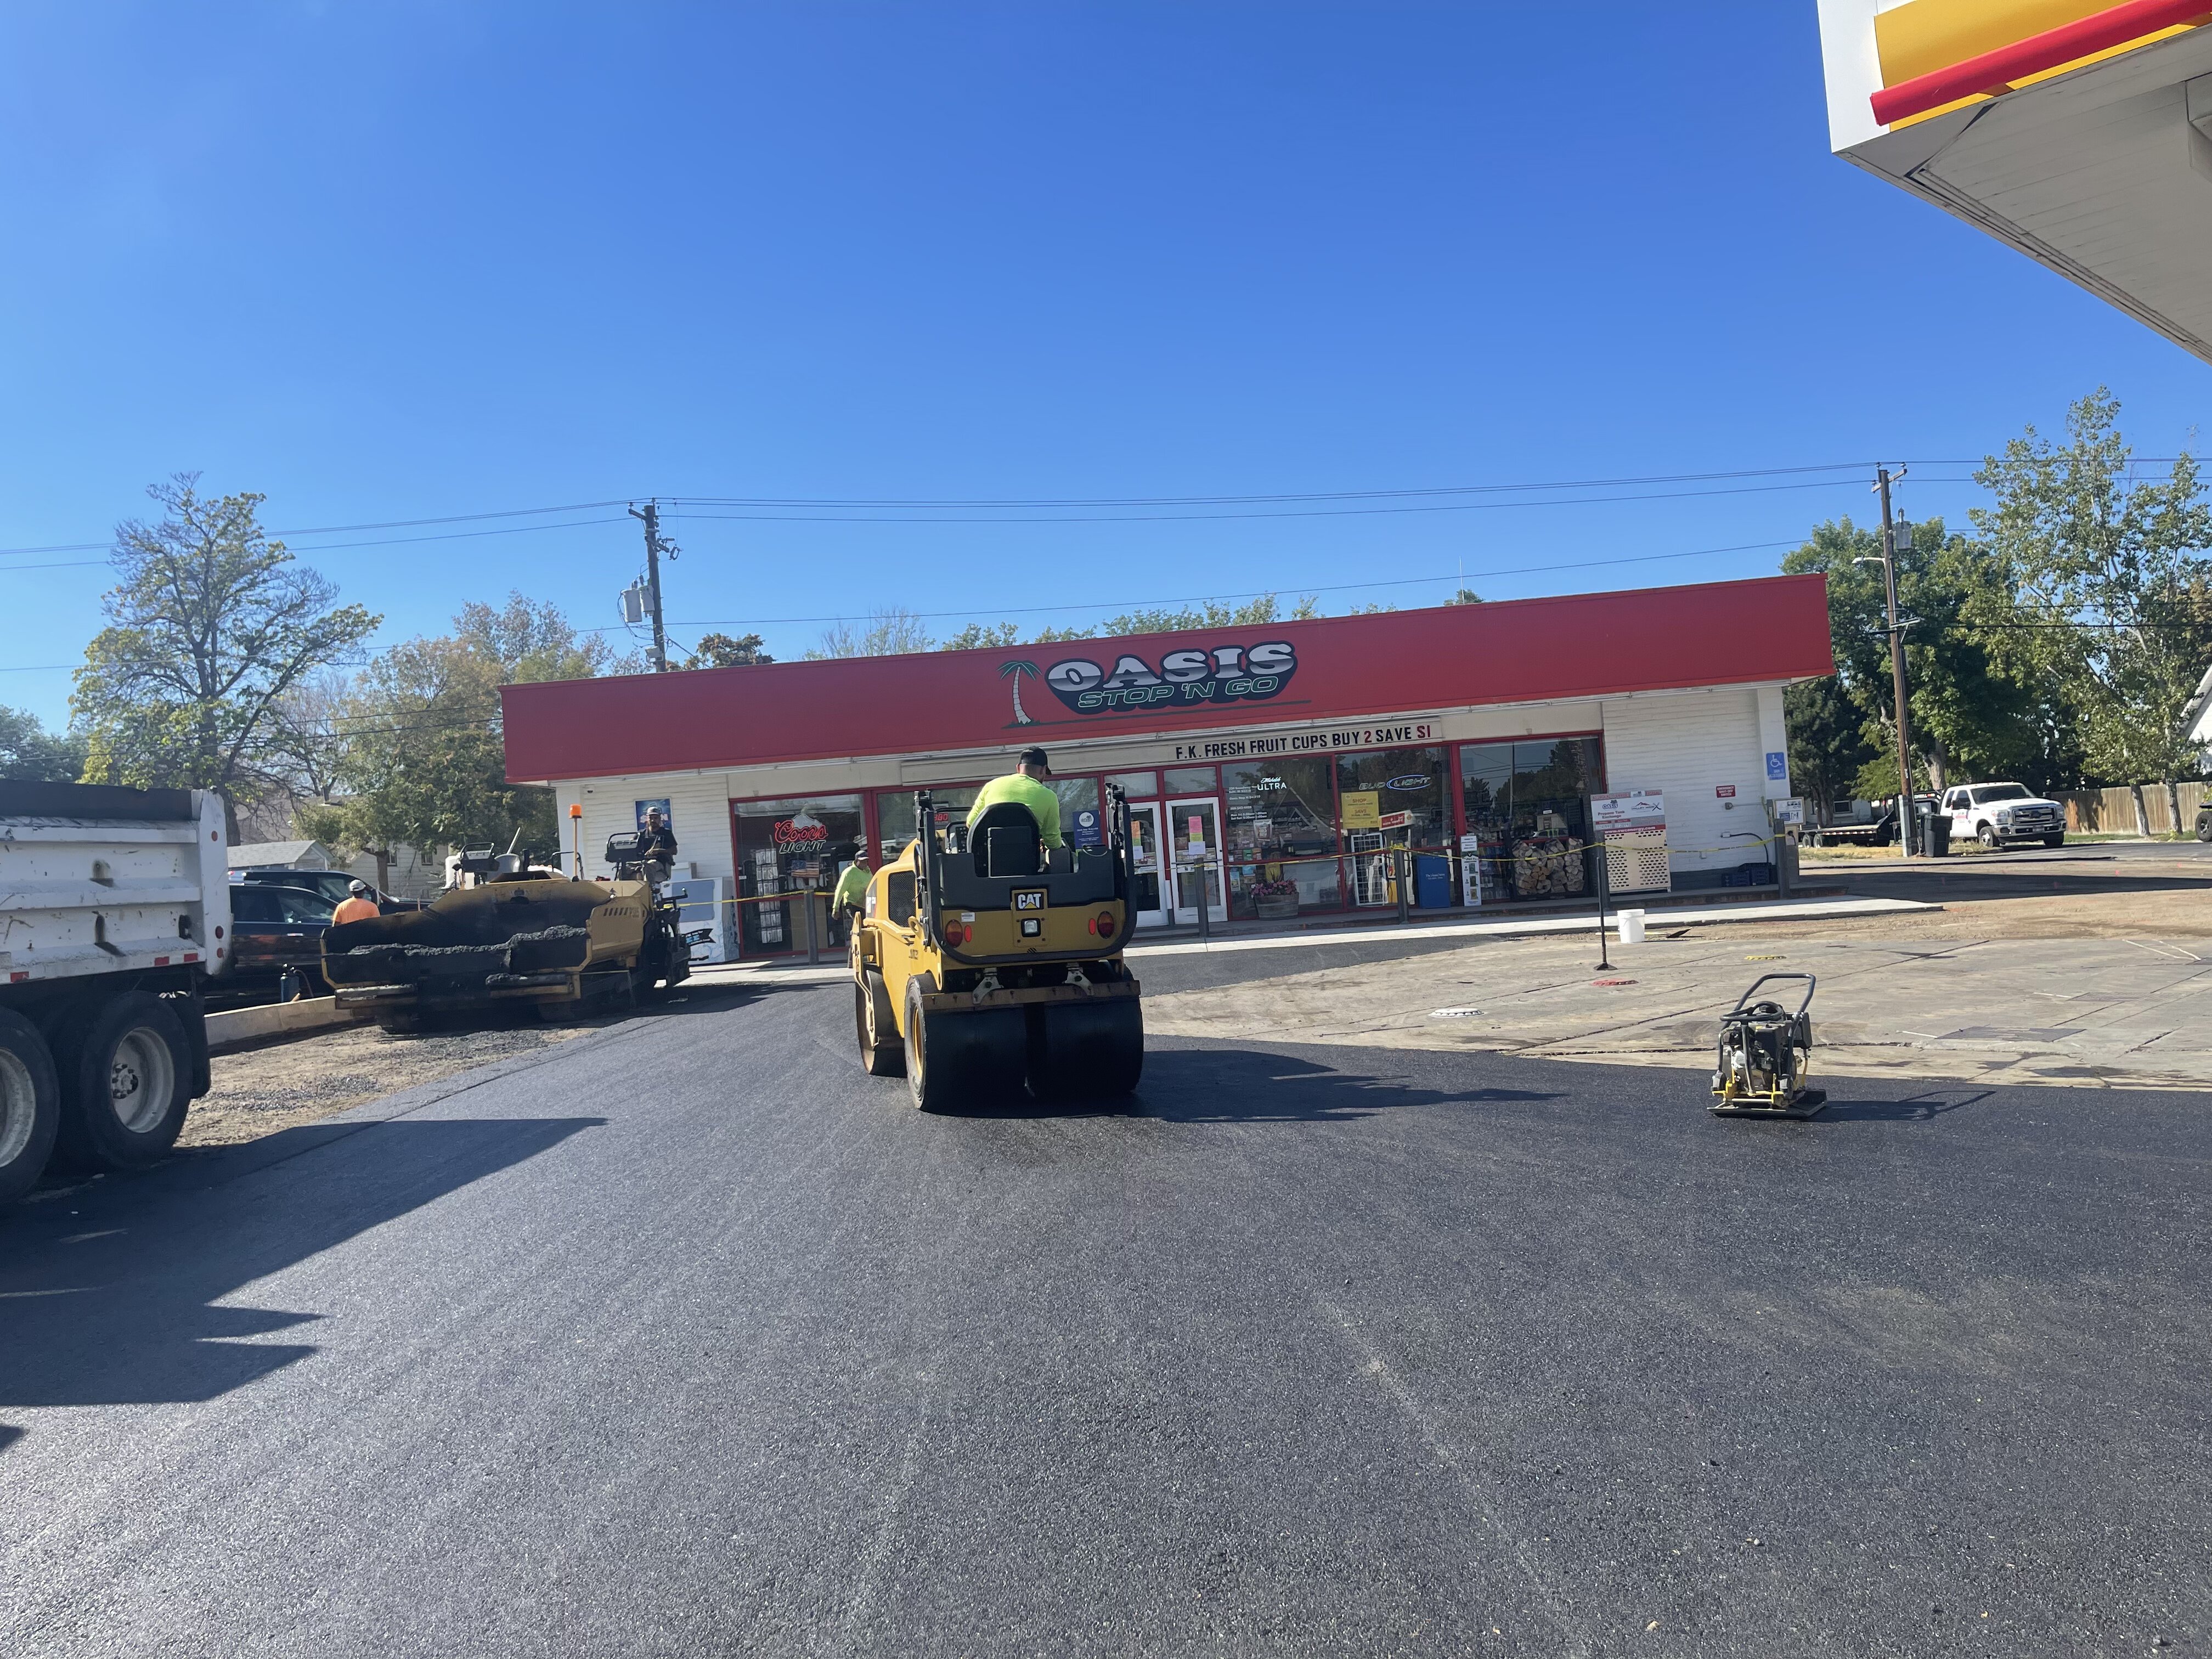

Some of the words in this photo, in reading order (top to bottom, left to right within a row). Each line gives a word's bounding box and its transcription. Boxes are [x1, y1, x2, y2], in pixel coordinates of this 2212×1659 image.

[1047, 642, 1295, 692] OASIS
[1077, 685, 1175, 708] STOP
[1224, 675, 1279, 696] GO
[1176, 744, 1202, 759] F.K.
[1205, 740, 1245, 757] FRESH
[1250, 737, 1287, 753] FRUIT
[1292, 734, 1327, 749] CUPS
[1332, 731, 1359, 746] BUY
[1364, 731, 1372, 743] 2
[1375, 727, 1412, 742] SAVE
[1257, 782, 1287, 791] ULTRA
[1359, 782, 1386, 791] BUD
[1394, 777, 1431, 787] LIGHT
[775, 820, 829, 843] Coors
[779, 839, 827, 854] LIGHT
[1018, 894, 1041, 909] CAT
